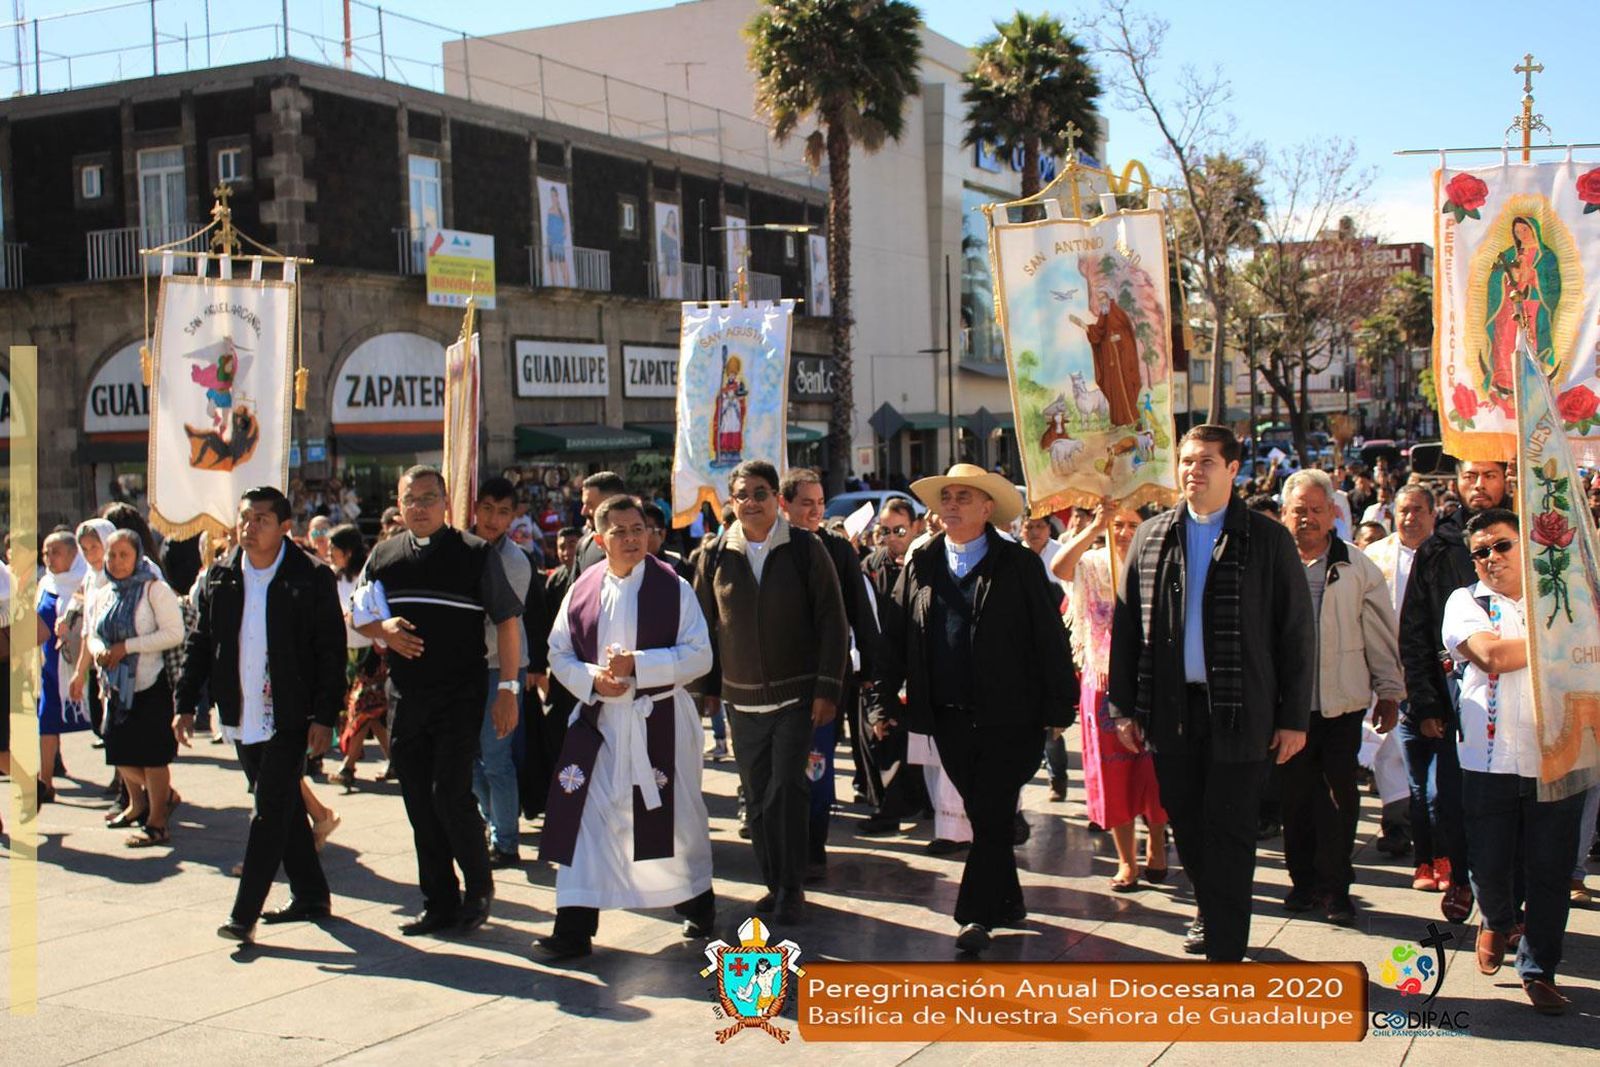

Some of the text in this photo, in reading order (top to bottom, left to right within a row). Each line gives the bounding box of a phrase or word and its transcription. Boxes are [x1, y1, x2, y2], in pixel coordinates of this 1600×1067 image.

[1022, 252, 1047, 277] SAN
[523, 353, 605, 385] GUADALUPE
[346, 374, 445, 408] ZAPATER
